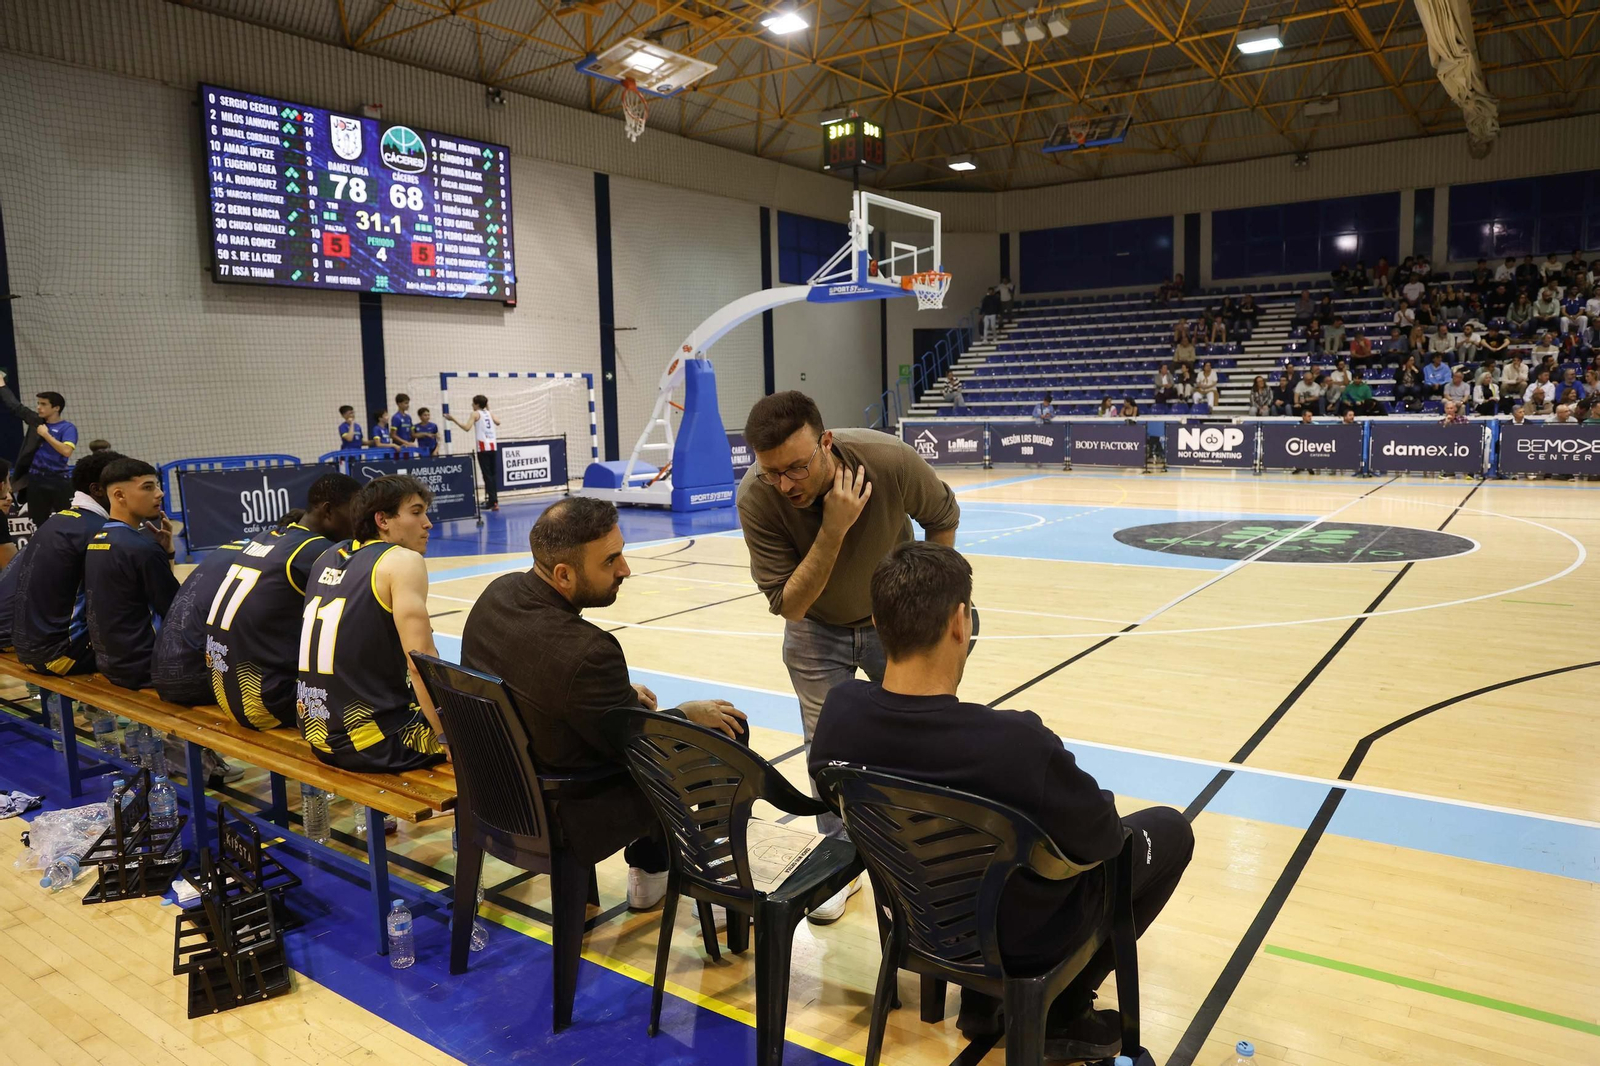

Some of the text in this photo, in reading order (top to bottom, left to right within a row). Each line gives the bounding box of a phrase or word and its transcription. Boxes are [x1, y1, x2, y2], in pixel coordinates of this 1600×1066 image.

[209, 93, 314, 123] 0 SERGIO CECILIA 22
[210, 109, 314, 137] 2 MILOS JANKOVIC 14
[211, 125, 217, 135] 6
[222, 128, 245, 138] ISMAEL
[306, 142, 311, 151] 6
[210, 140, 312, 166] 10 AMADI IKPEZE 3
[212, 156, 313, 180] 11 EUGENIO EGEA 0
[328, 161, 351, 173] DAMEX
[432, 151, 438, 160] 3
[499, 164, 504, 173] 2
[433, 164, 438, 174] 4
[213, 172, 318, 196] 14 A. RODRIGUEZ 10
[330, 174, 367, 203] 78
[433, 177, 438, 187] 7
[214, 187, 223, 198] 15
[309, 200, 315, 209] 0
[390, 184, 423, 210] 68
[215, 203, 318, 224] 22 BERNI GARCIA 11
[434, 204, 440, 213] 11
[216, 218, 320, 238] 30 CHUSO GONZALEZ 10
[356, 211, 401, 234] 31.1
[434, 216, 442, 226] 12
[217, 234, 318, 253] 40 RAFA GOMEZ 0
[331, 238, 342, 252] 5
[218, 249, 319, 268] 50 S. DE LA CRUZ 0
[376, 247, 387, 261] 4
[419, 247, 428, 261] 5
[436, 256, 444, 265] 22
[220, 265, 319, 282] 77 ISSA THIAM 2
[436, 269, 444, 278] 24
[437, 282, 445, 291] 26
[1001, 434, 1054, 446] MESÓN LAS DUELAS
[1076, 441, 1139, 451] BODY FACTORY
[1178, 427, 1244, 452] NOP
[505, 450, 521, 458] BAR
[1382, 440, 1469, 457] damex.io
[1528, 453, 1592, 461] CENTER
[411, 464, 463, 476] AMBULANCIAS
[506, 456, 547, 468] CAFETERÍA
[508, 469, 546, 480] CENTRO
[241, 476, 289, 524] soho
[298, 596, 346, 675] 11
[225, 833, 252, 863] KIPSTA
